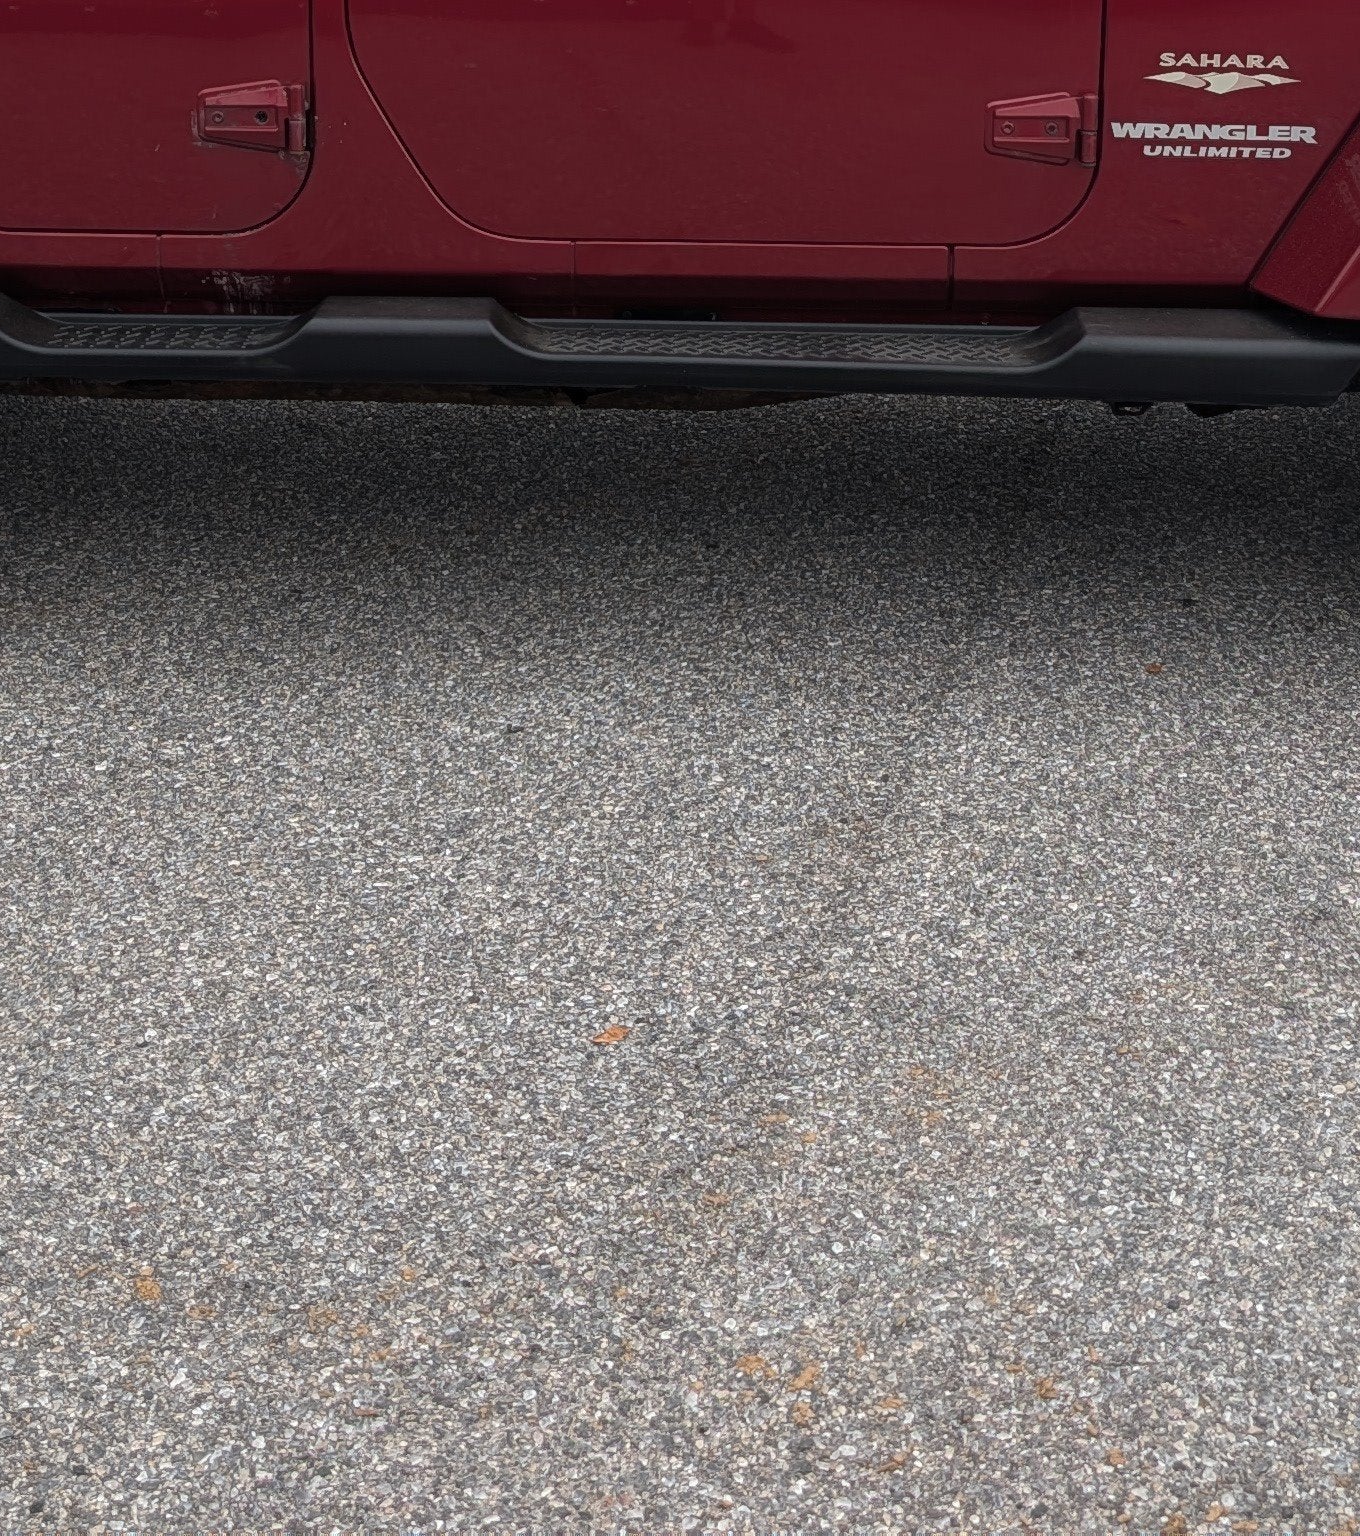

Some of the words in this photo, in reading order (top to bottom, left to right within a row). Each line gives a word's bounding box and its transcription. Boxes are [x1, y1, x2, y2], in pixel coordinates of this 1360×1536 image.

[1159, 52, 1289, 69] SAHARA
[1110, 122, 1318, 144] WRANGLER
[1143, 145, 1291, 159] UNLIMITED
